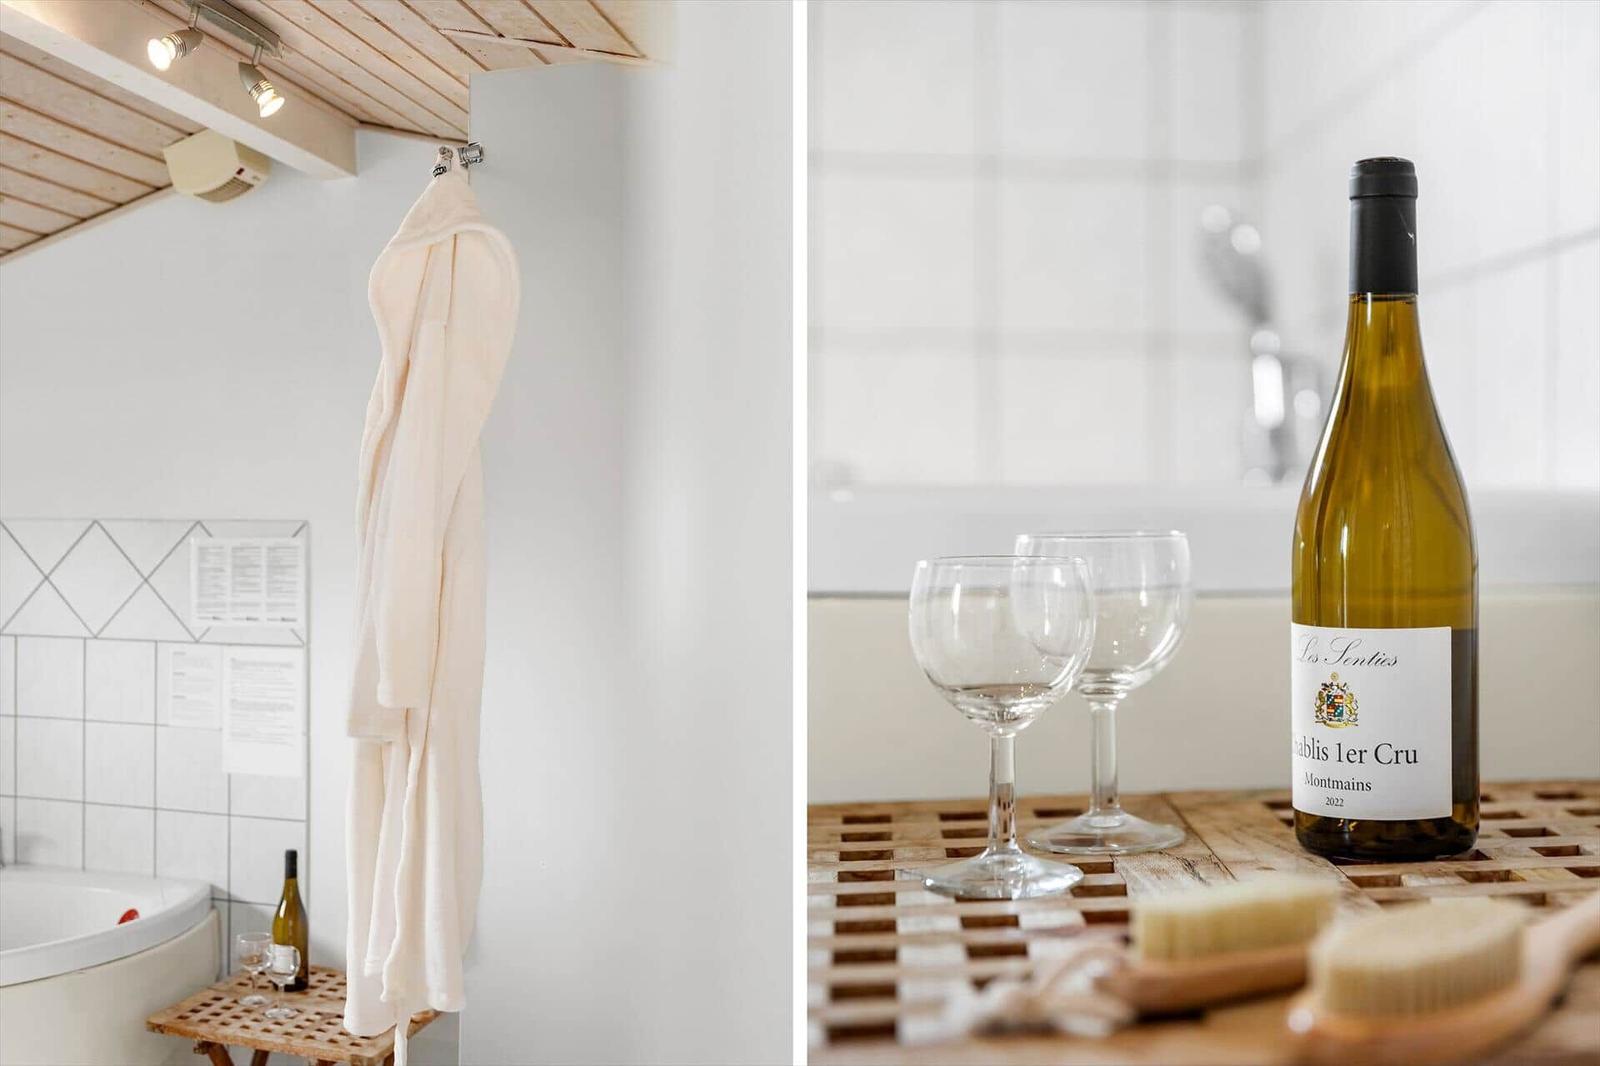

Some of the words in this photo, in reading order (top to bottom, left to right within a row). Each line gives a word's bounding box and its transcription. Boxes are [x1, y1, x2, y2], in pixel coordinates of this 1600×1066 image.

[1298, 634, 1319, 664] Les
[1294, 735, 1329, 762] ablis
[1336, 742, 1368, 764] 1er
[1374, 742, 1419, 765] Cru
[1304, 771, 1373, 792] Montmains
[1325, 796, 1345, 808] 2022
